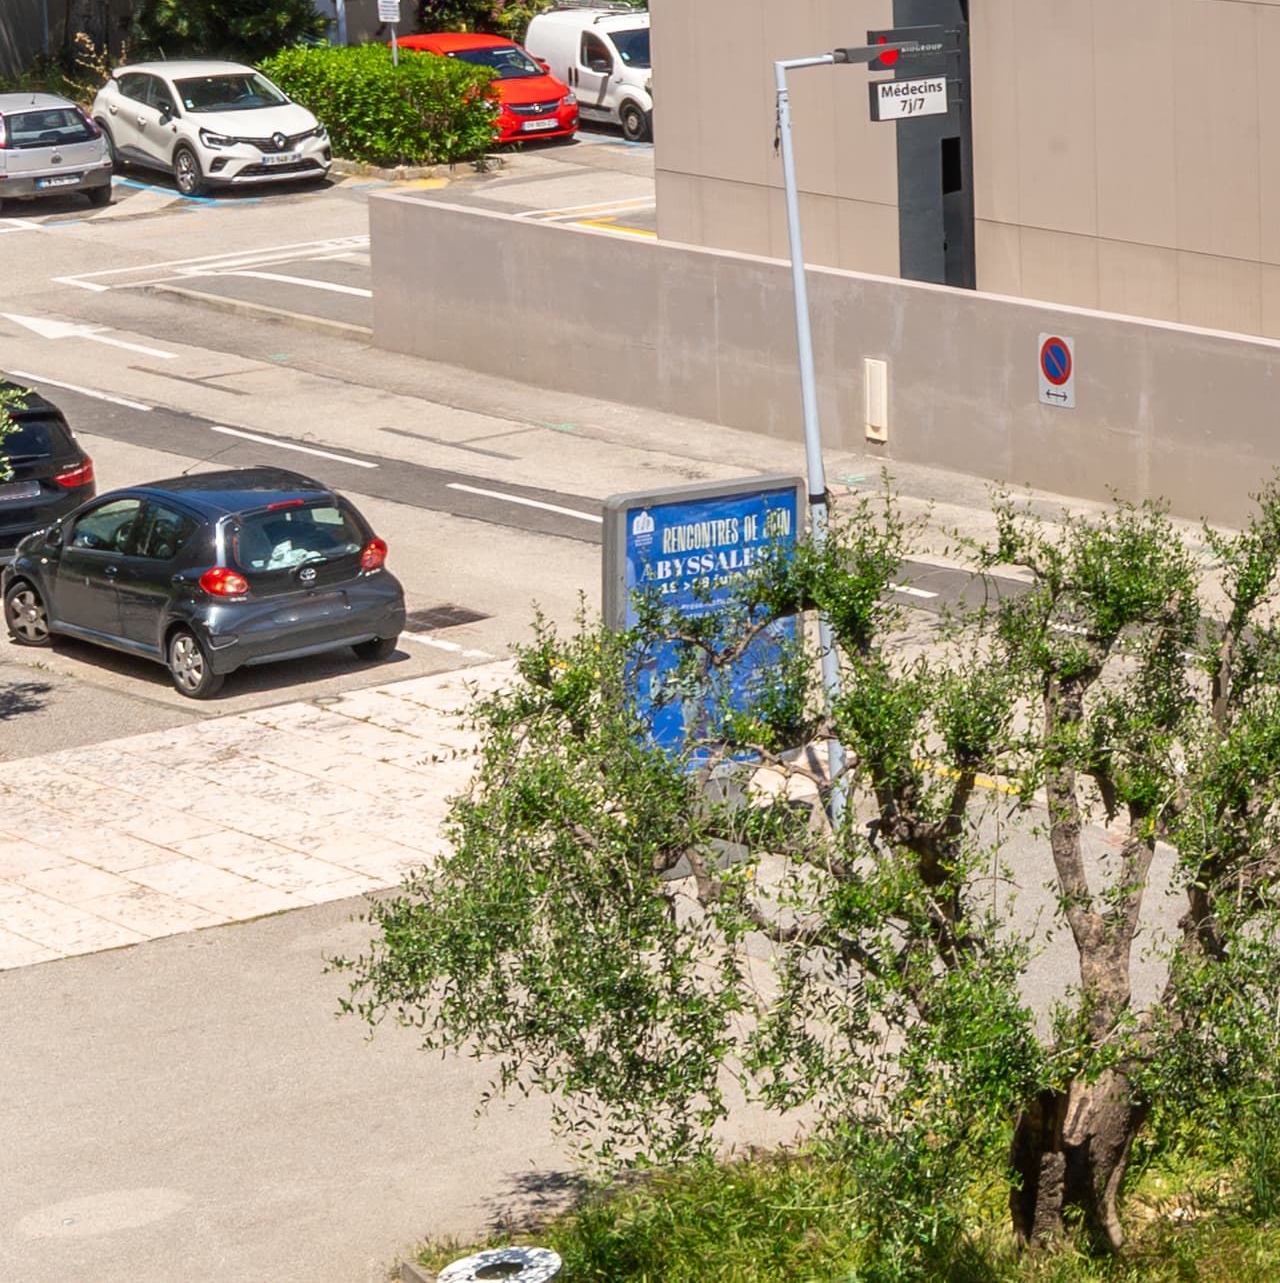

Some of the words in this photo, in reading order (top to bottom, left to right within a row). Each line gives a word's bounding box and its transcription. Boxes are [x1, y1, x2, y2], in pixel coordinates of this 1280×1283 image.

[881, 81, 943, 98] Médecins
[900, 98, 925, 114] 7j/7
[663, 517, 739, 554] RENCONTRES
[744, 514, 758, 542] DE
